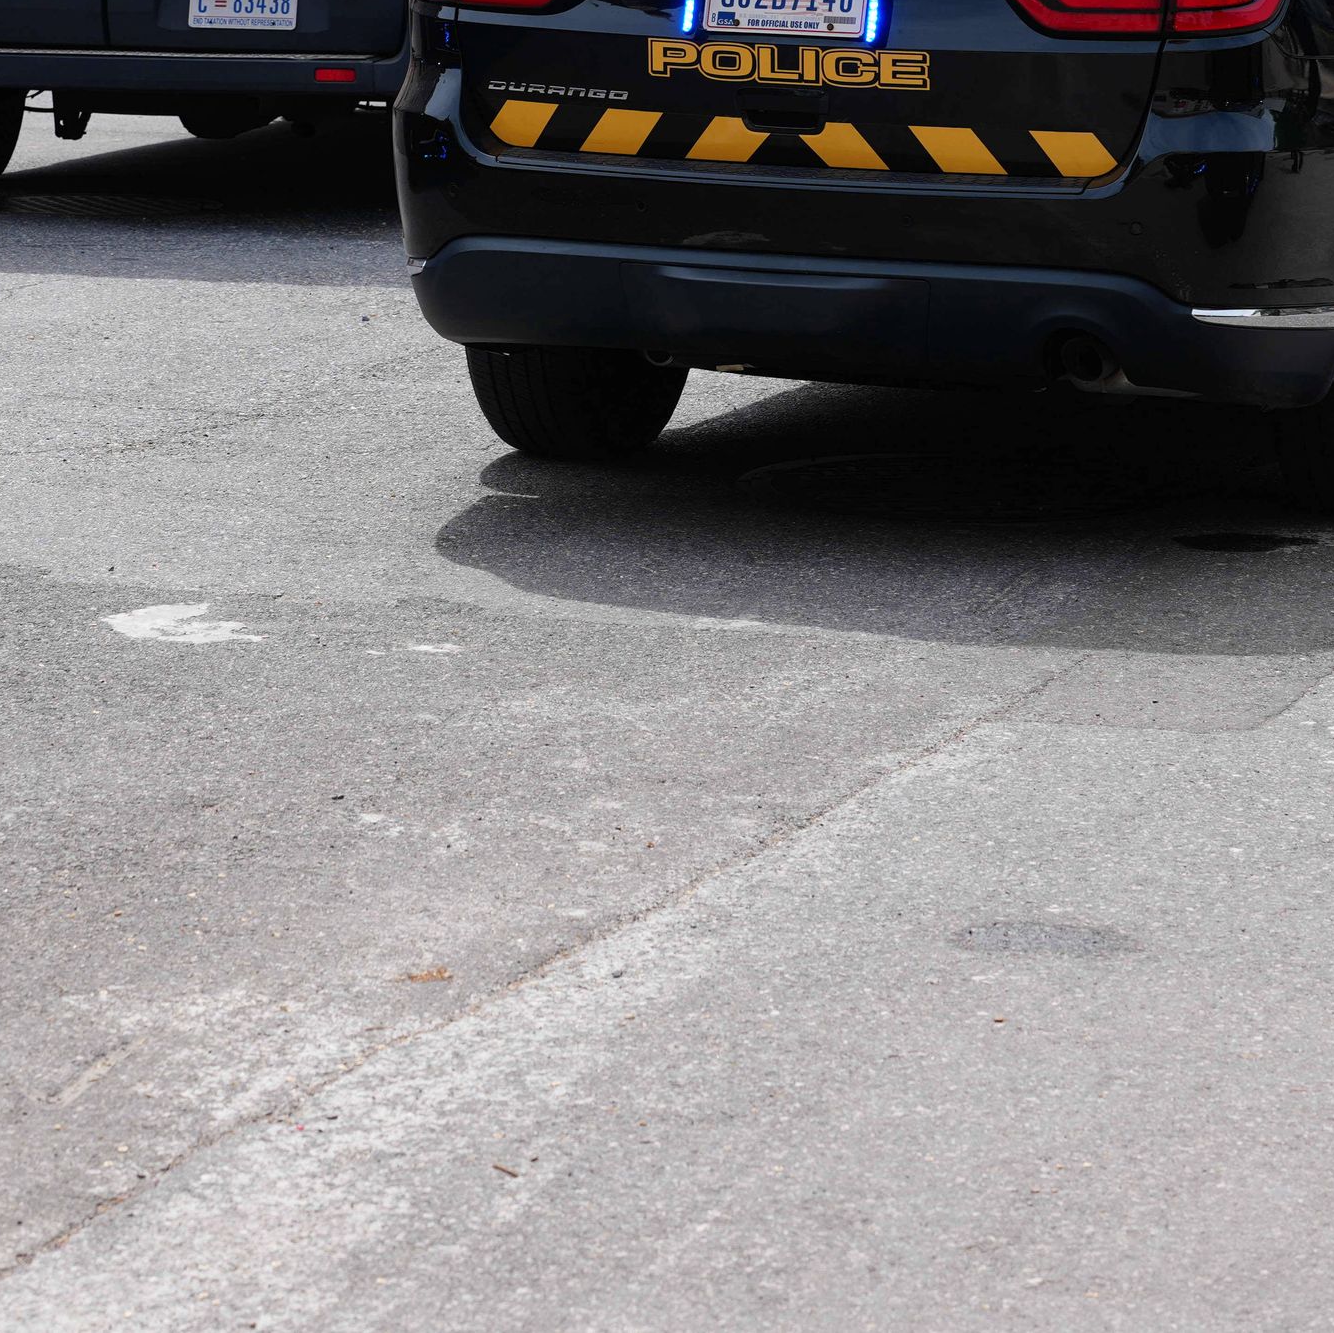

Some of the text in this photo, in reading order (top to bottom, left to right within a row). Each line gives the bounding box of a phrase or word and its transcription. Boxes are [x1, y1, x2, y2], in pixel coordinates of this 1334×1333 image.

[193, 17, 204, 25] END
[747, 18, 820, 30] FOR OFFICIAL USE ONLY
[647, 38, 931, 91] POLICE
[488, 80, 629, 101] DURANGO
